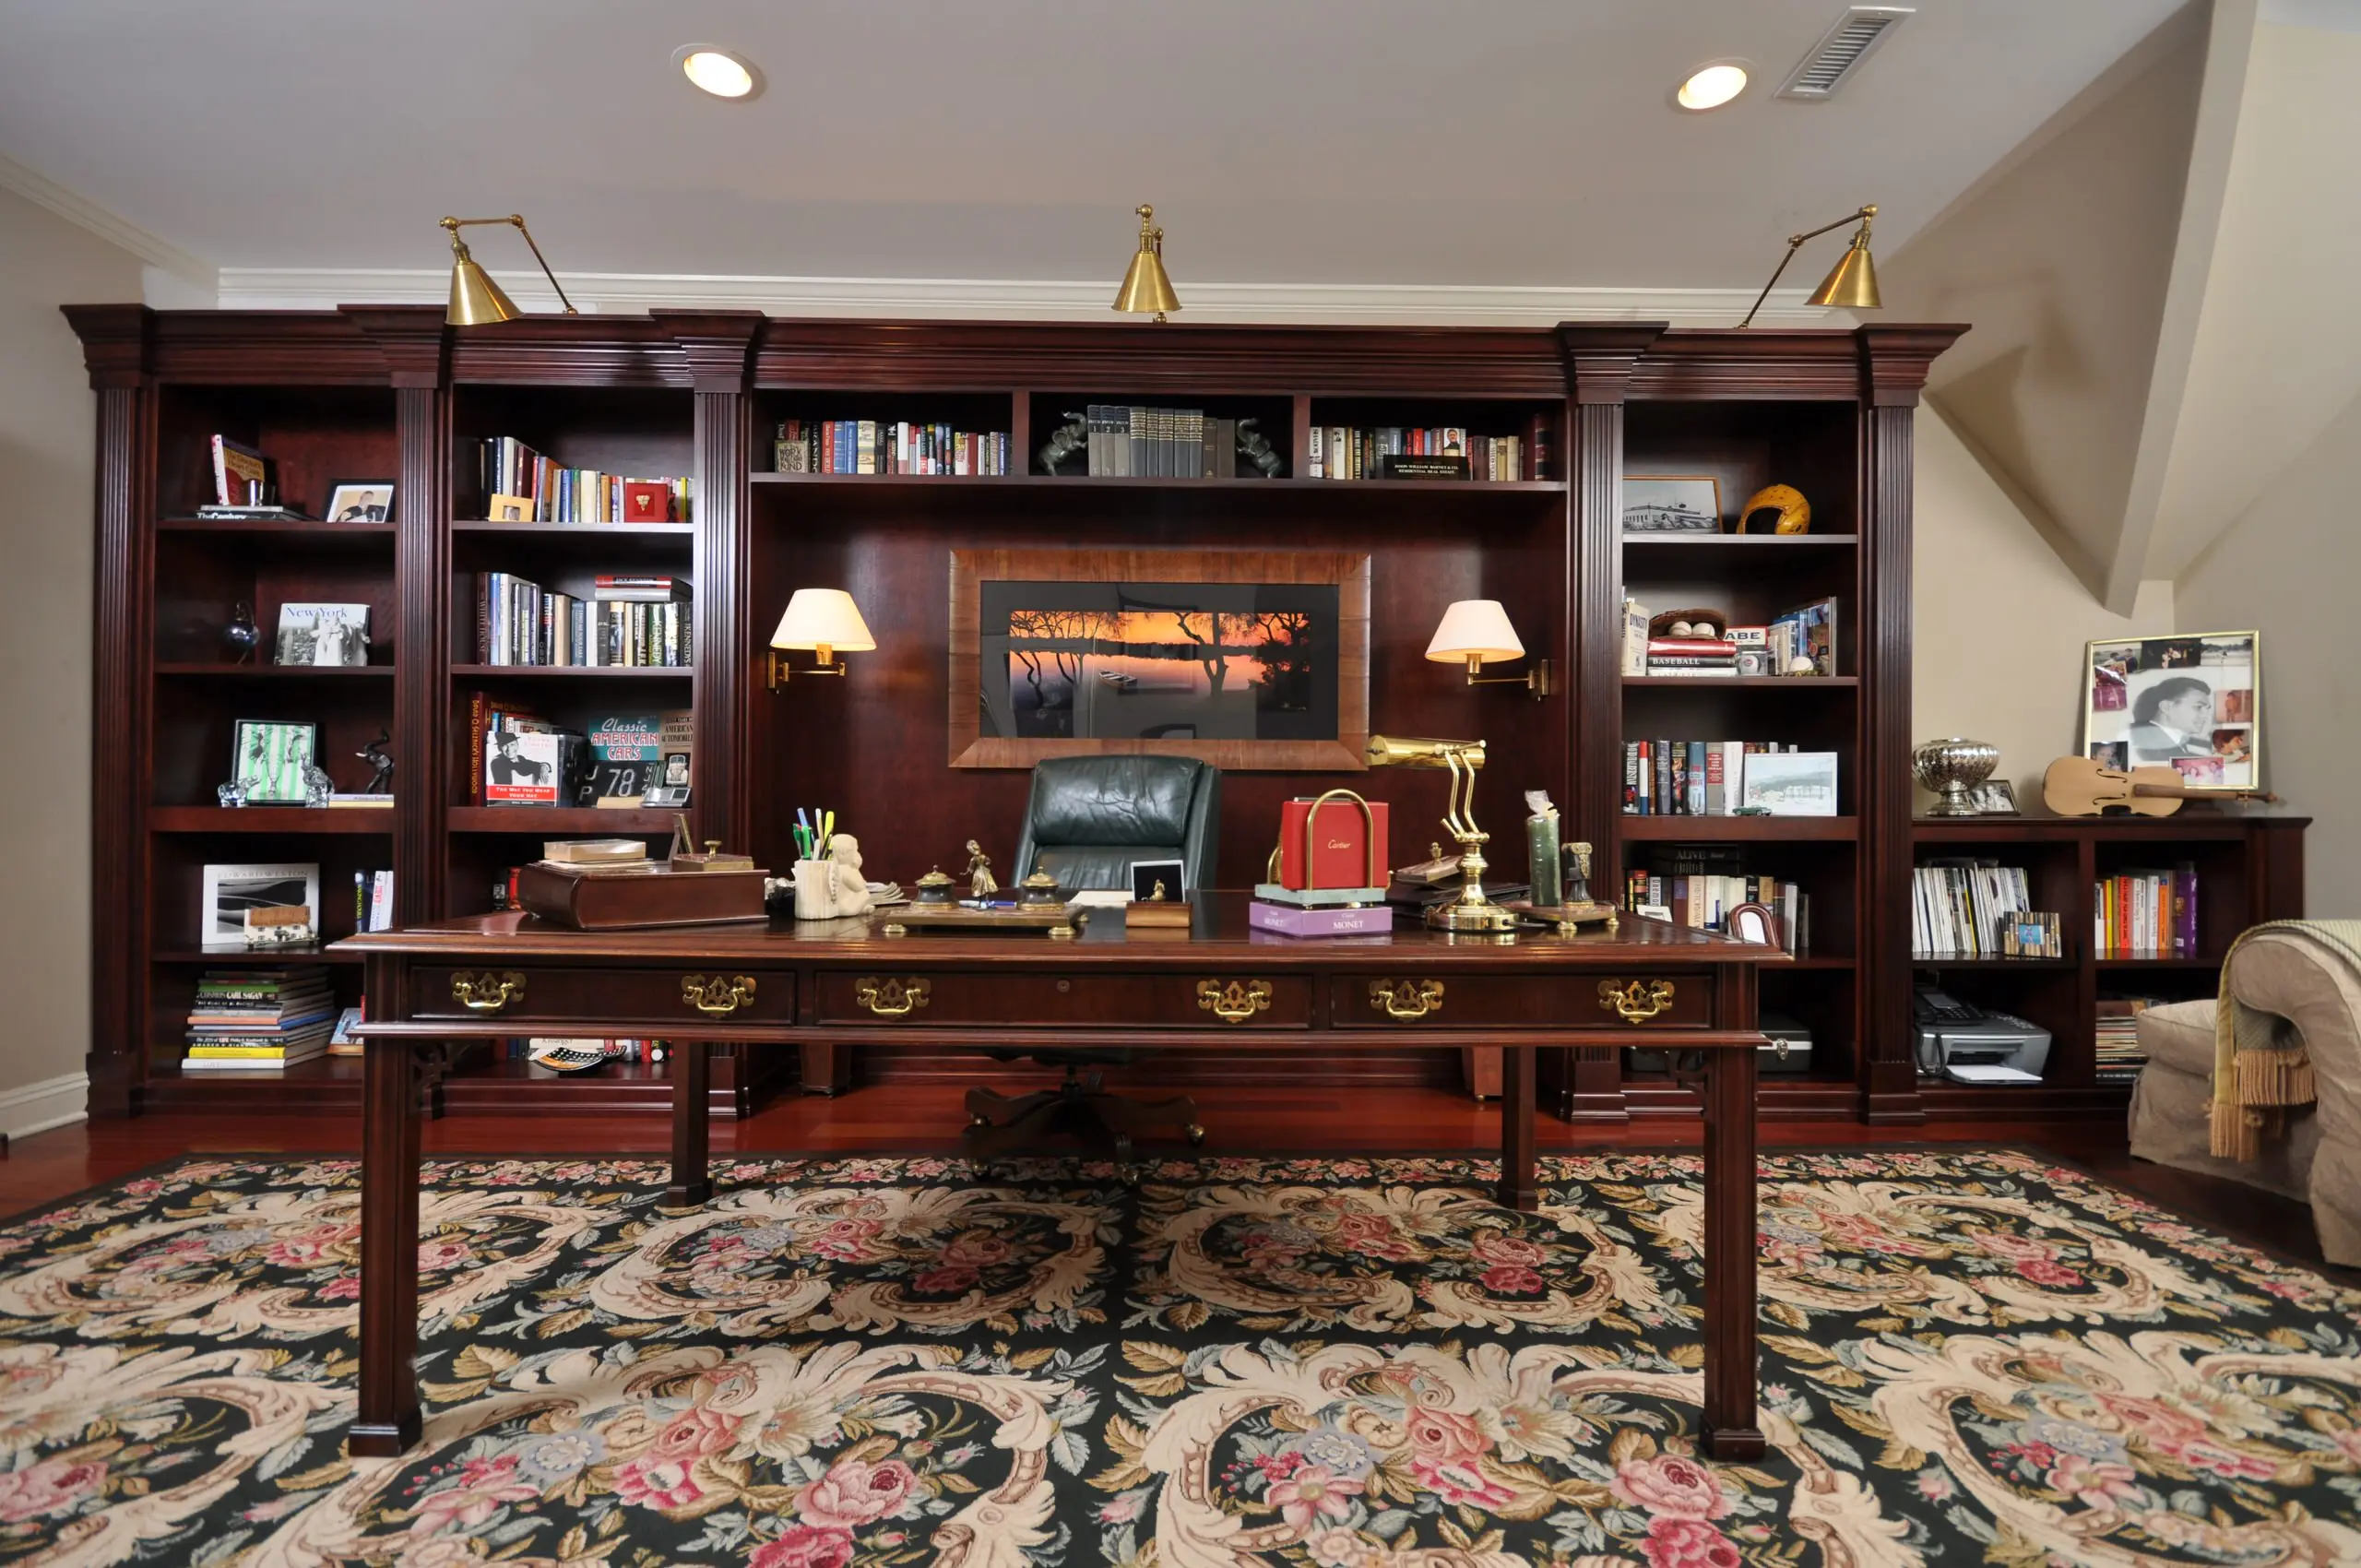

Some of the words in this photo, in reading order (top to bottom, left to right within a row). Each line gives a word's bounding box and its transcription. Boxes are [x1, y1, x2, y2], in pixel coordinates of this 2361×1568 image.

[286, 606, 317, 618] New
[318, 606, 348, 618] York
[652, 620, 662, 664] KENNEDY
[1725, 632, 1761, 640] ABE
[602, 718, 647, 732] Classic
[591, 732, 659, 746] AMERICAN
[607, 747, 642, 761] CARS
[605, 768, 636, 797] 78
[1328, 839, 1351, 849] Cartier
[1333, 920, 1364, 930] MONET
